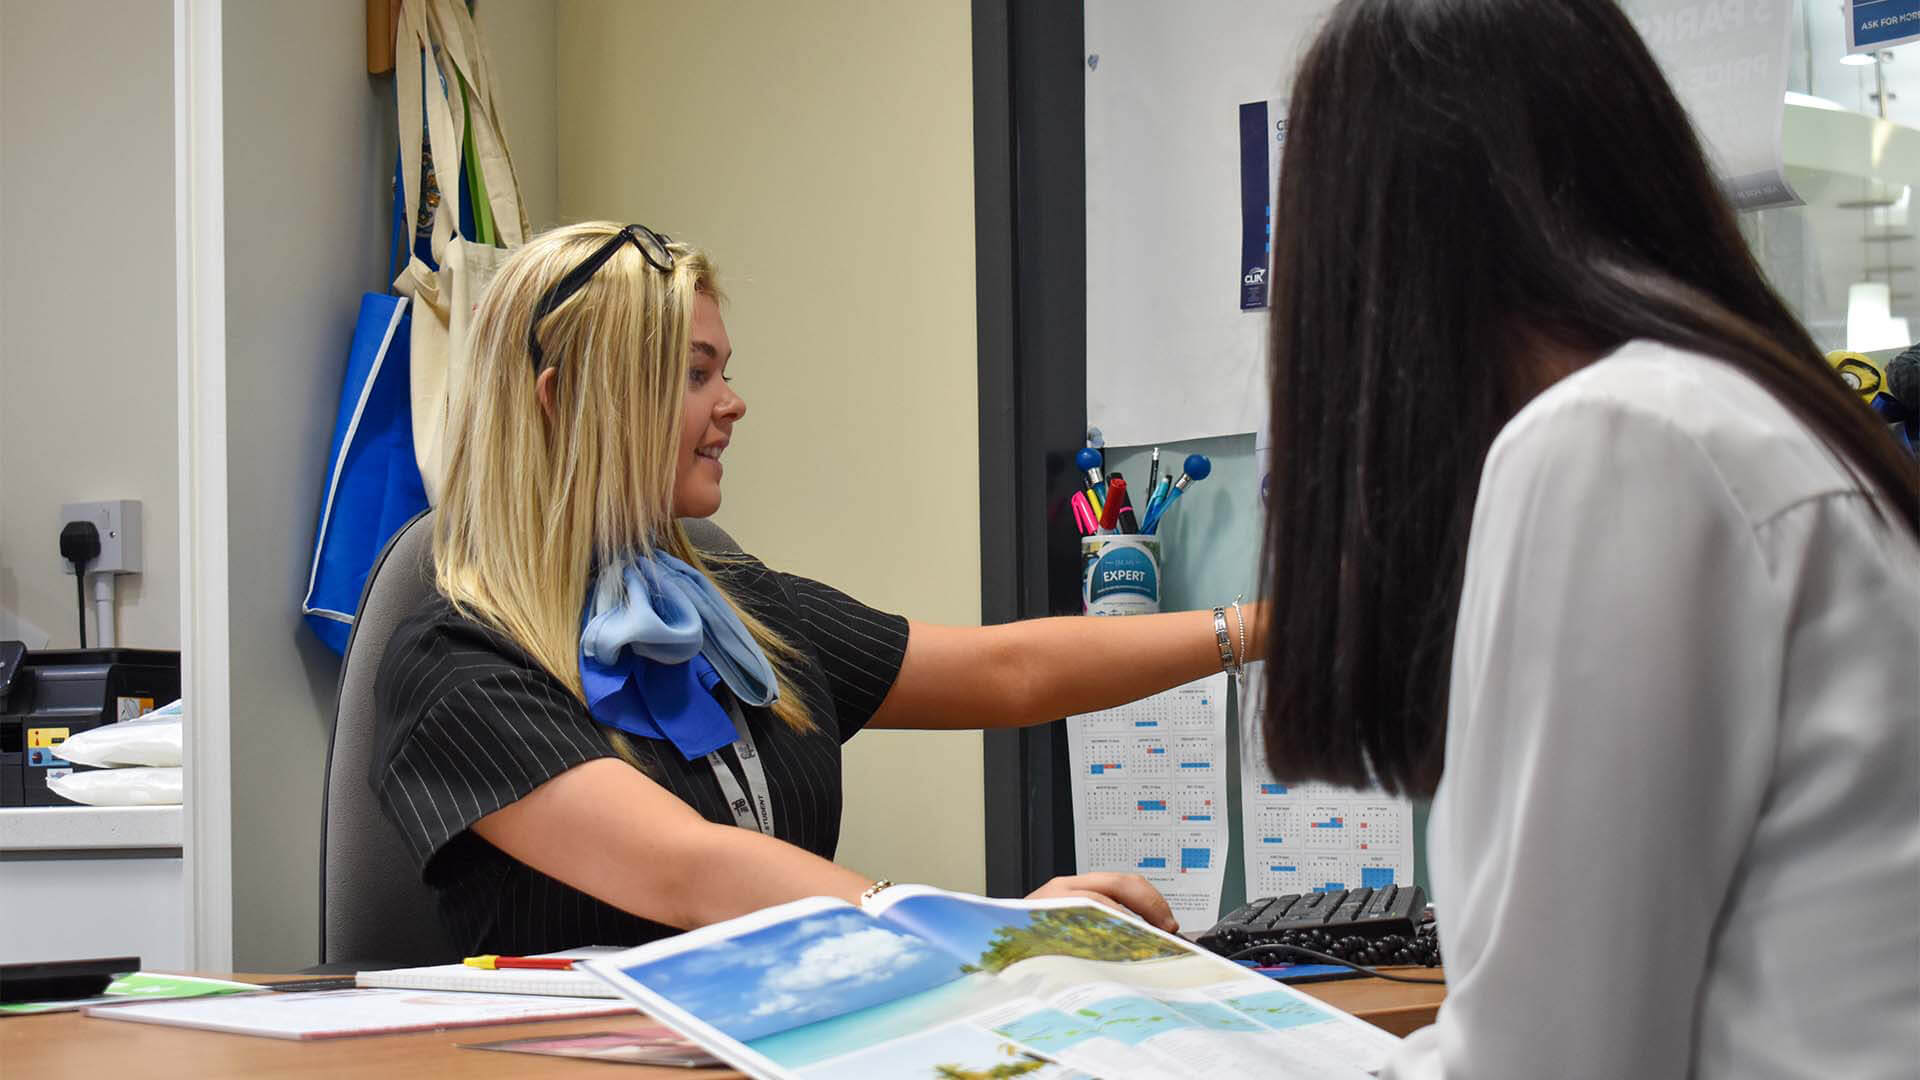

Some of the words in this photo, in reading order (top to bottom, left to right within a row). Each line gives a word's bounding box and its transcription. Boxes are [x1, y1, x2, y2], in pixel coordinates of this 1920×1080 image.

[1861, 20, 1879, 31] ASK
[1880, 16, 1898, 28] FOR
[1103, 569, 1145, 582] EXPERT
[758, 794, 770, 831] STUDENT
